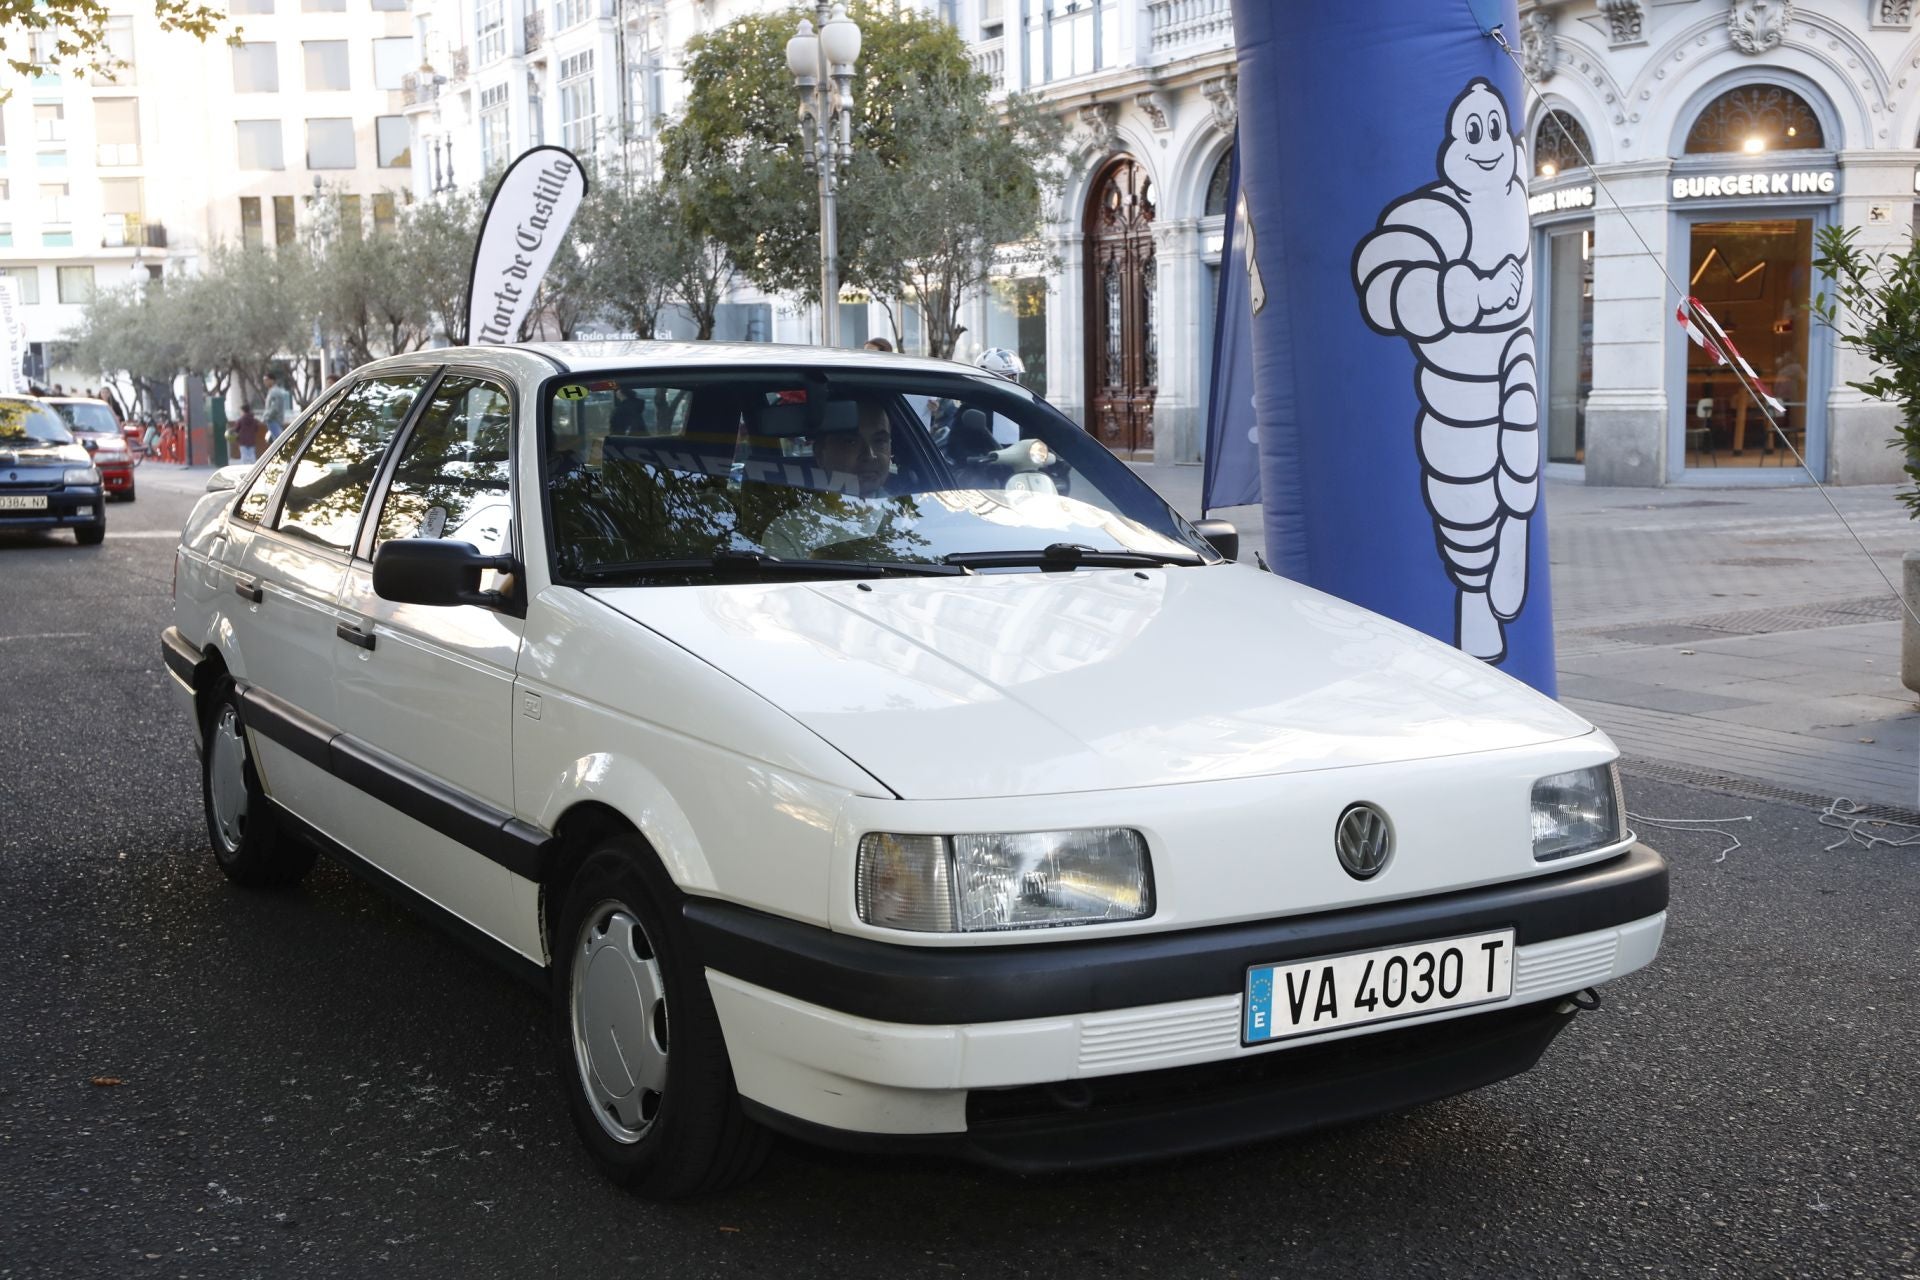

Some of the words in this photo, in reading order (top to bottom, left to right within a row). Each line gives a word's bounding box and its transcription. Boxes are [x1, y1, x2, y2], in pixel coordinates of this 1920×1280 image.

[1556, 186, 1593, 209] KING
[1672, 174, 1770, 199] BURGER
[1770, 172, 1835, 195] KING
[516, 159, 573, 251] Castilla
[502, 254, 532, 280] de
[478, 282, 522, 345] Norte
[575, 331, 604, 340] Todo
[562, 386, 583, 399] H
[1254, 1011, 1265, 1028] E
[1286, 966, 1338, 1025] VA
[1354, 947, 1464, 1012] 4030
[1481, 940, 1503, 993] T
